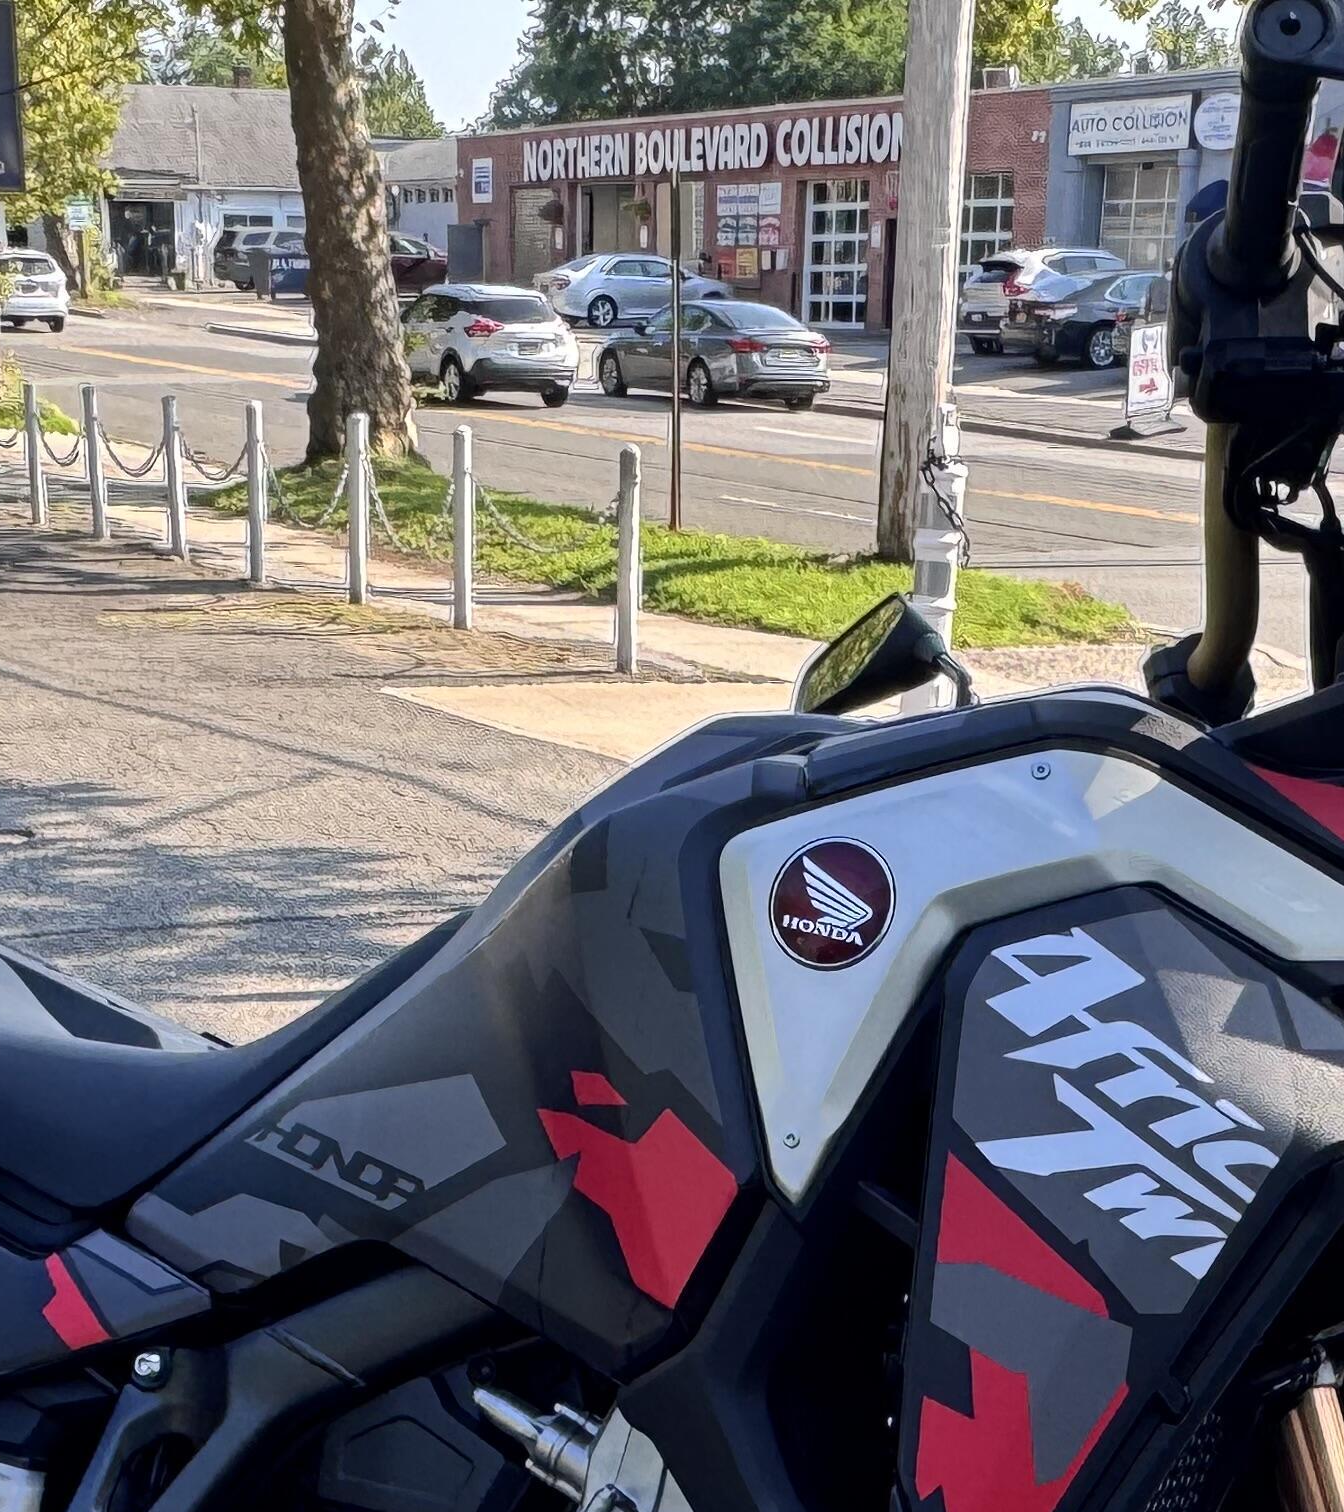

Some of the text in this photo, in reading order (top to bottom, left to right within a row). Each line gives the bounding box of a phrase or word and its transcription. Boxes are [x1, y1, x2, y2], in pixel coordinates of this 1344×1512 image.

[1071, 118, 1108, 134] AUTO
[523, 132, 630, 182] NORTHERN
[634, 122, 769, 175] BOULEVARD
[782, 914, 864, 947] HONDA
